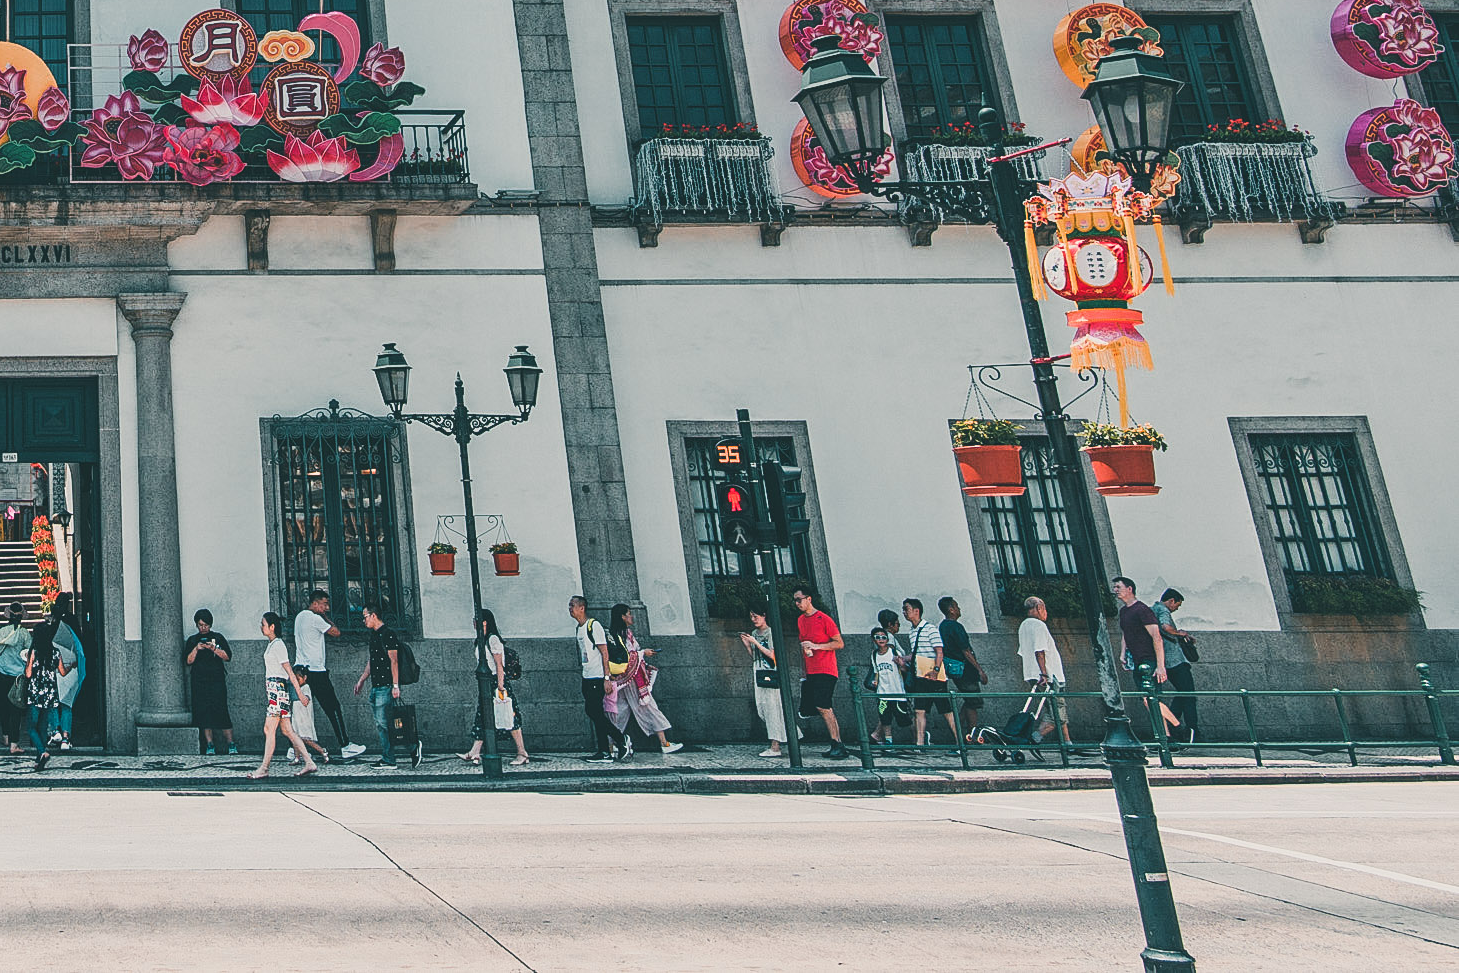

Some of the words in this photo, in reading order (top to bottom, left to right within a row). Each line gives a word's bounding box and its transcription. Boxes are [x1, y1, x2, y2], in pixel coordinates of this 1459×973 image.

[191, 22, 240, 65] 月
[276, 76, 327, 119] 圓
[716, 445, 741, 463] 35
